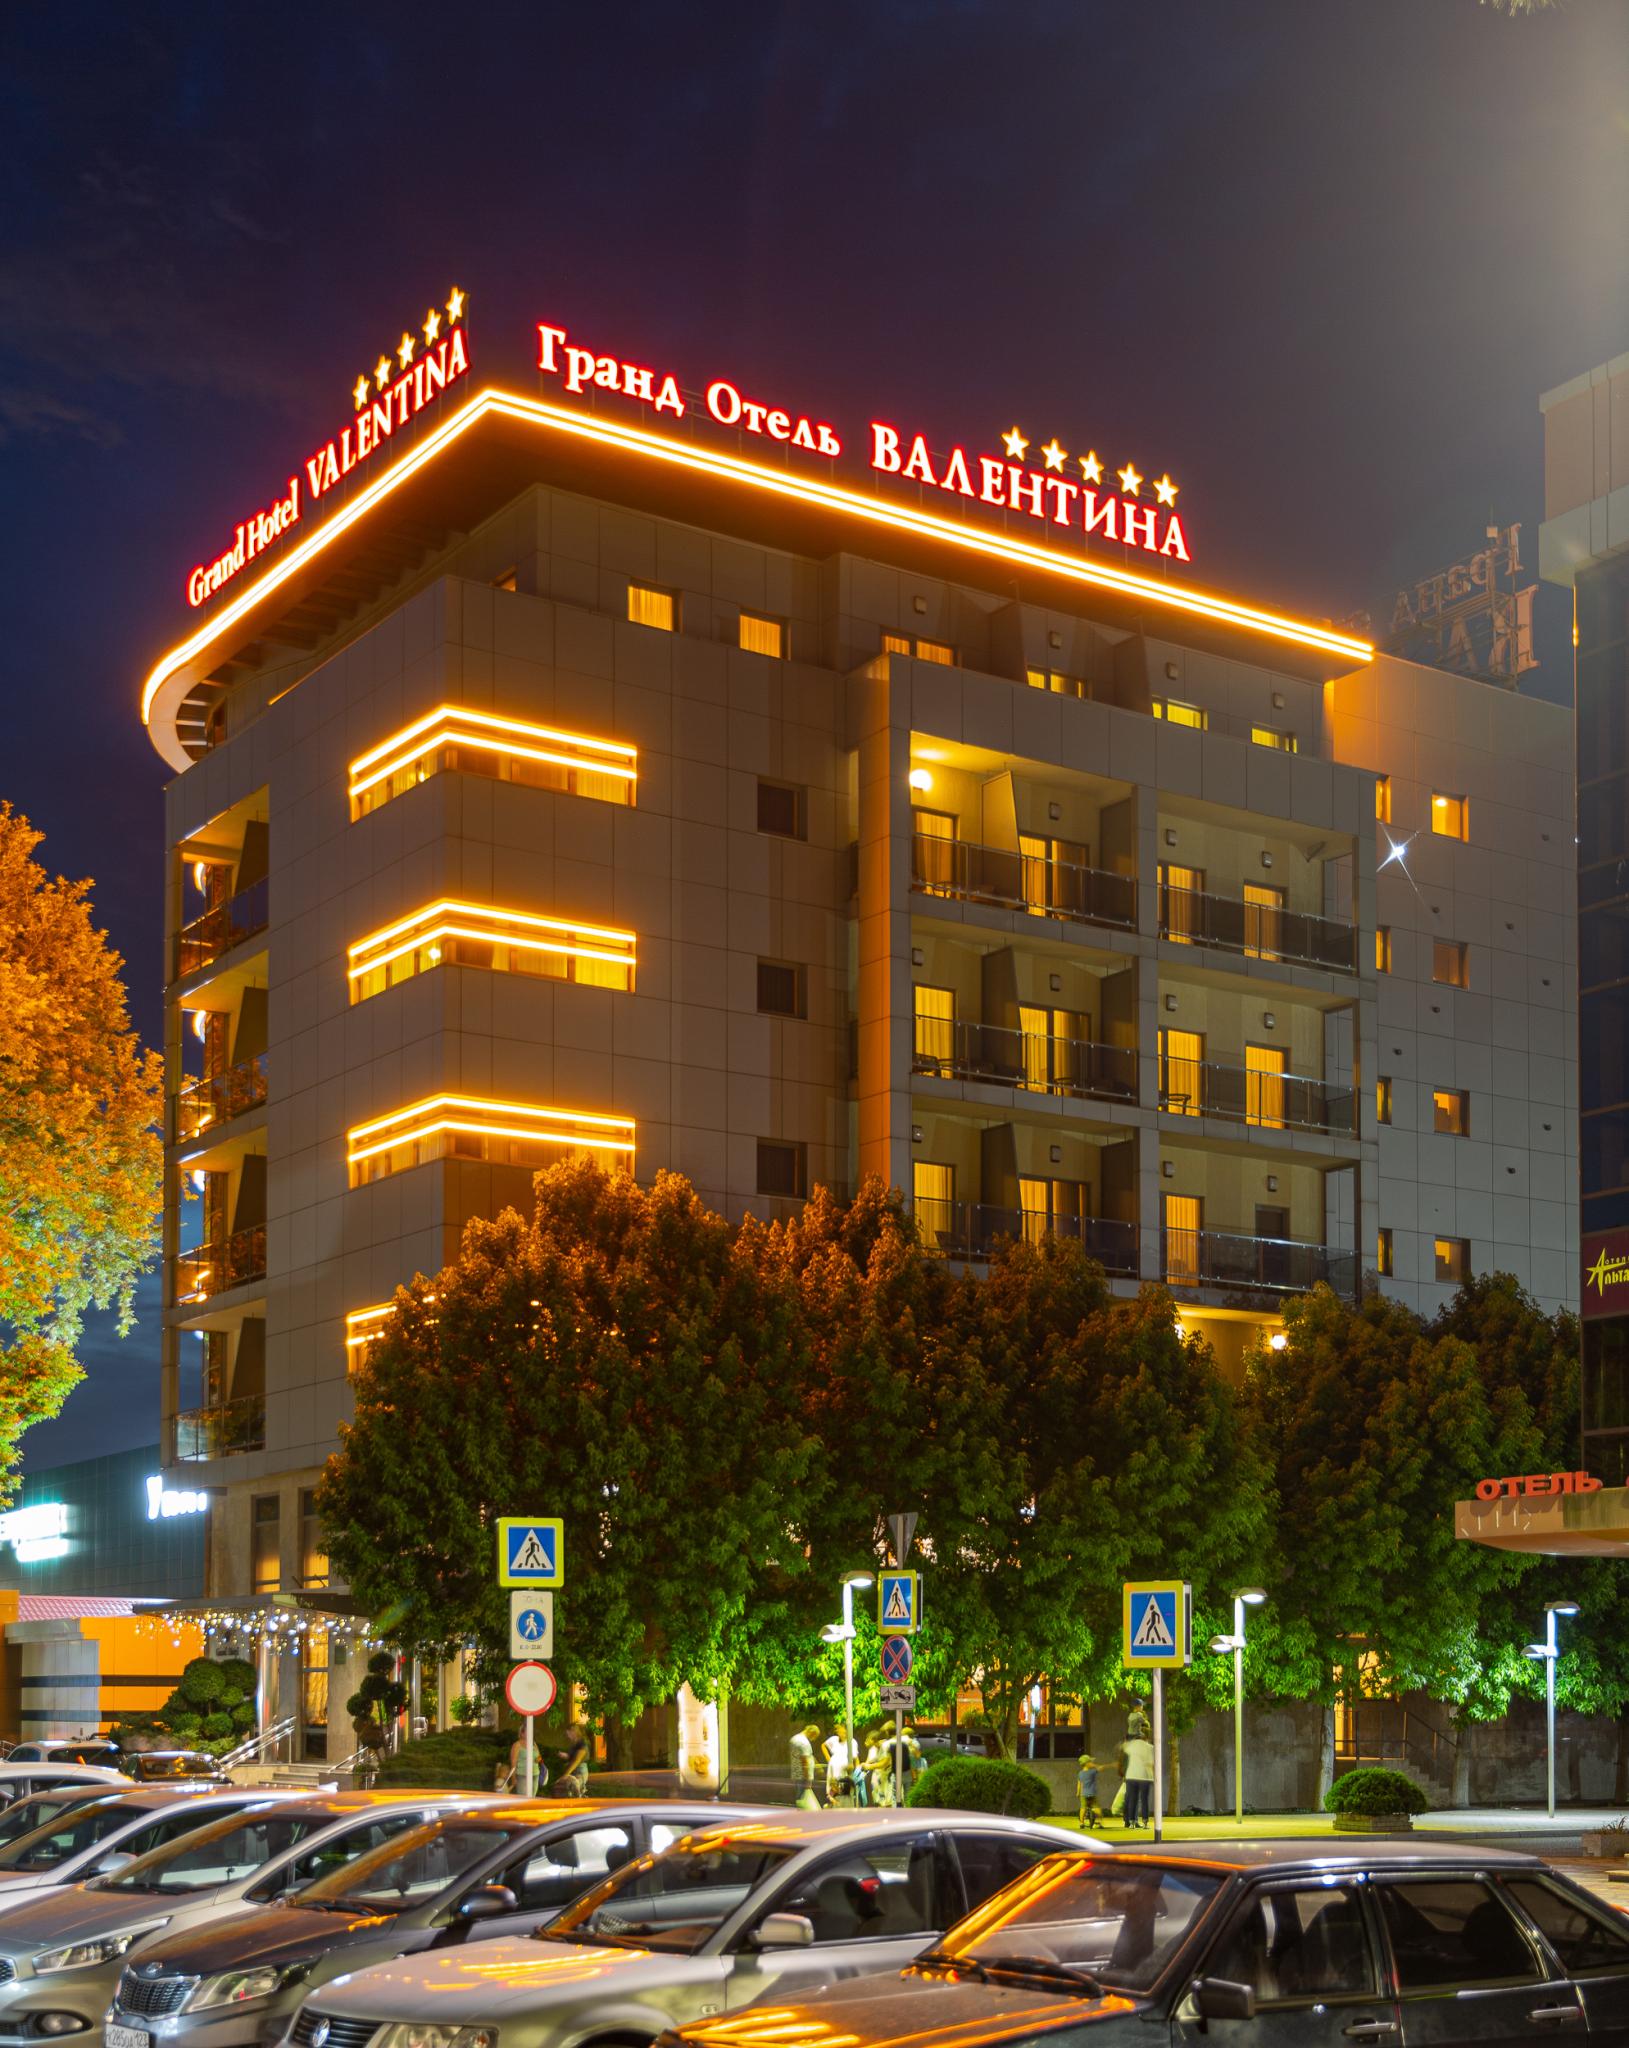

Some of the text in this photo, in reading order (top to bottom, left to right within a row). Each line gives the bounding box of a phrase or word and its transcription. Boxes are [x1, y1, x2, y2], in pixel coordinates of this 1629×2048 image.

[187, 326, 471, 608] Grand Hotel VALENTINA
[537, 324, 1191, 563] Гранд Отель ВАЛЕНТИНА
[1604, 1255, 1629, 1265] отел
[1475, 1471, 1603, 1501] ОТЕЛЬ
